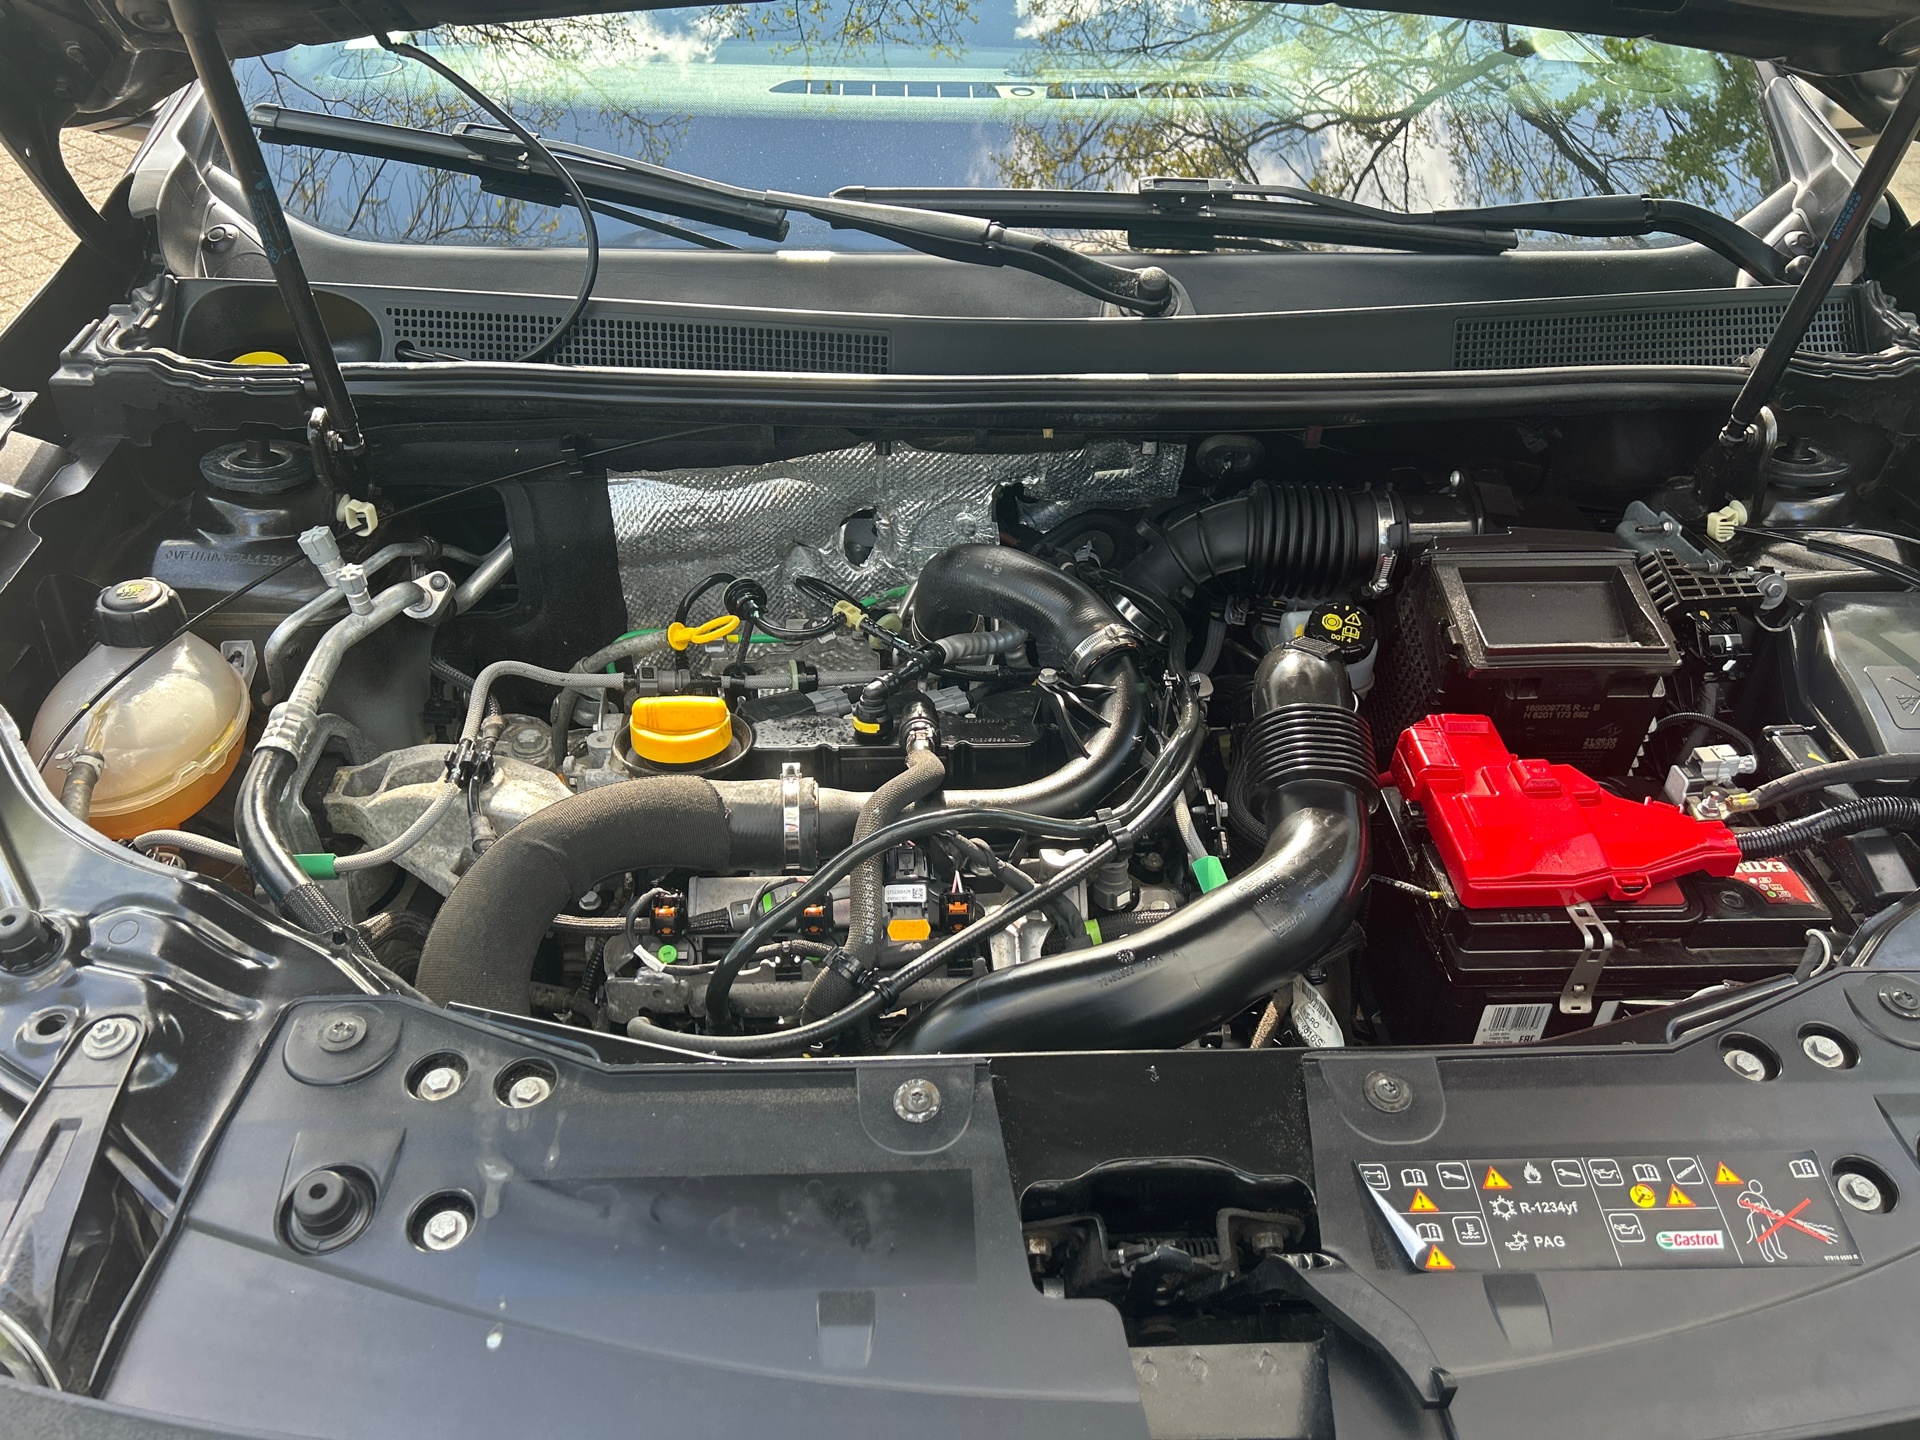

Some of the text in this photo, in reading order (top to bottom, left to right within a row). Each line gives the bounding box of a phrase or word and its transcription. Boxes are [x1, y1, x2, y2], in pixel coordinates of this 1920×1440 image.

[1330, 633, 1345, 642] DOT
[1519, 1200, 1578, 1215] R-1234yf
[1533, 1235, 1566, 1248] PAG
[1674, 1233, 1720, 1247] Castrol
